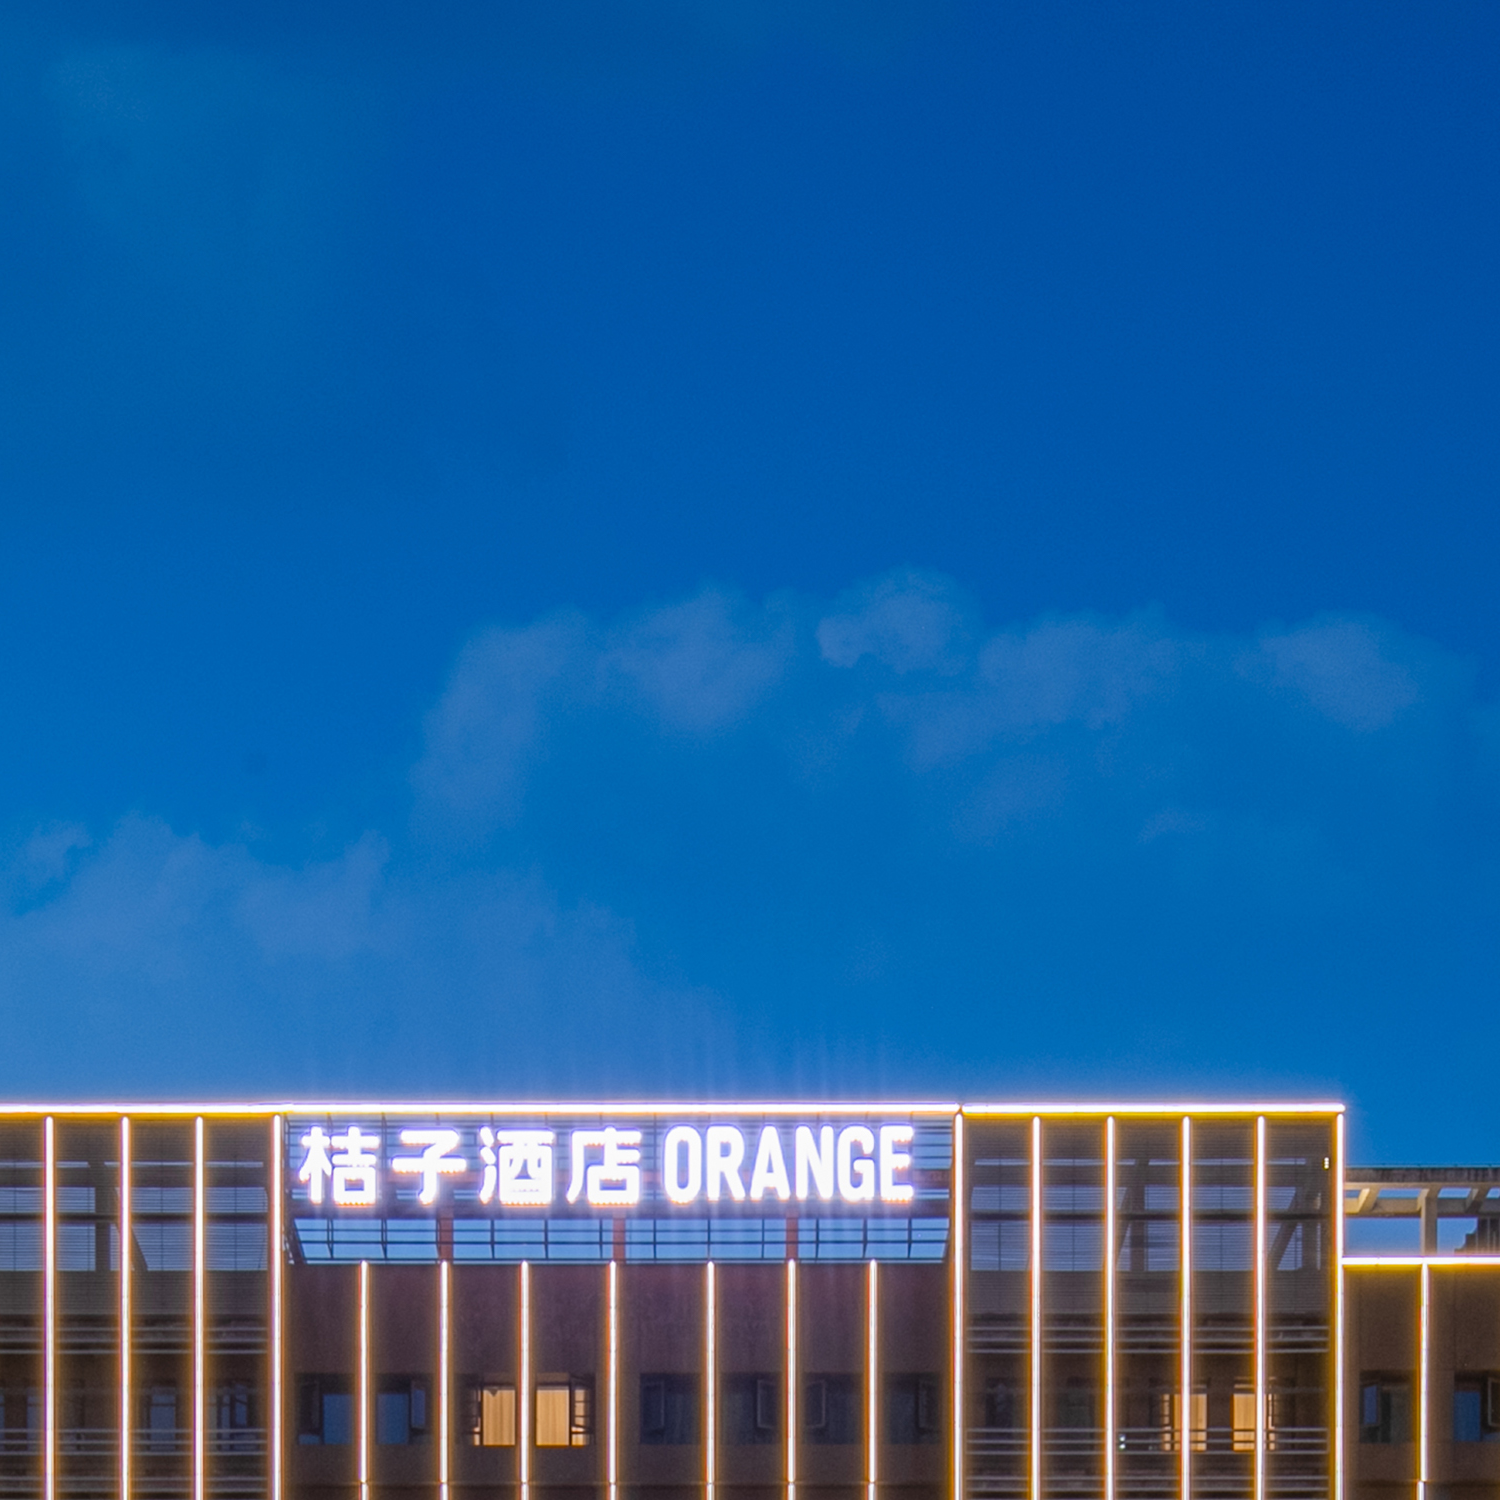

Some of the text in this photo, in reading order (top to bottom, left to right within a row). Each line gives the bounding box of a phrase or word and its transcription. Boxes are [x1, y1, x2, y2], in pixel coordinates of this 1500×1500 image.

[299, 1124, 915, 1206] 桔子酒店 ORANGE
